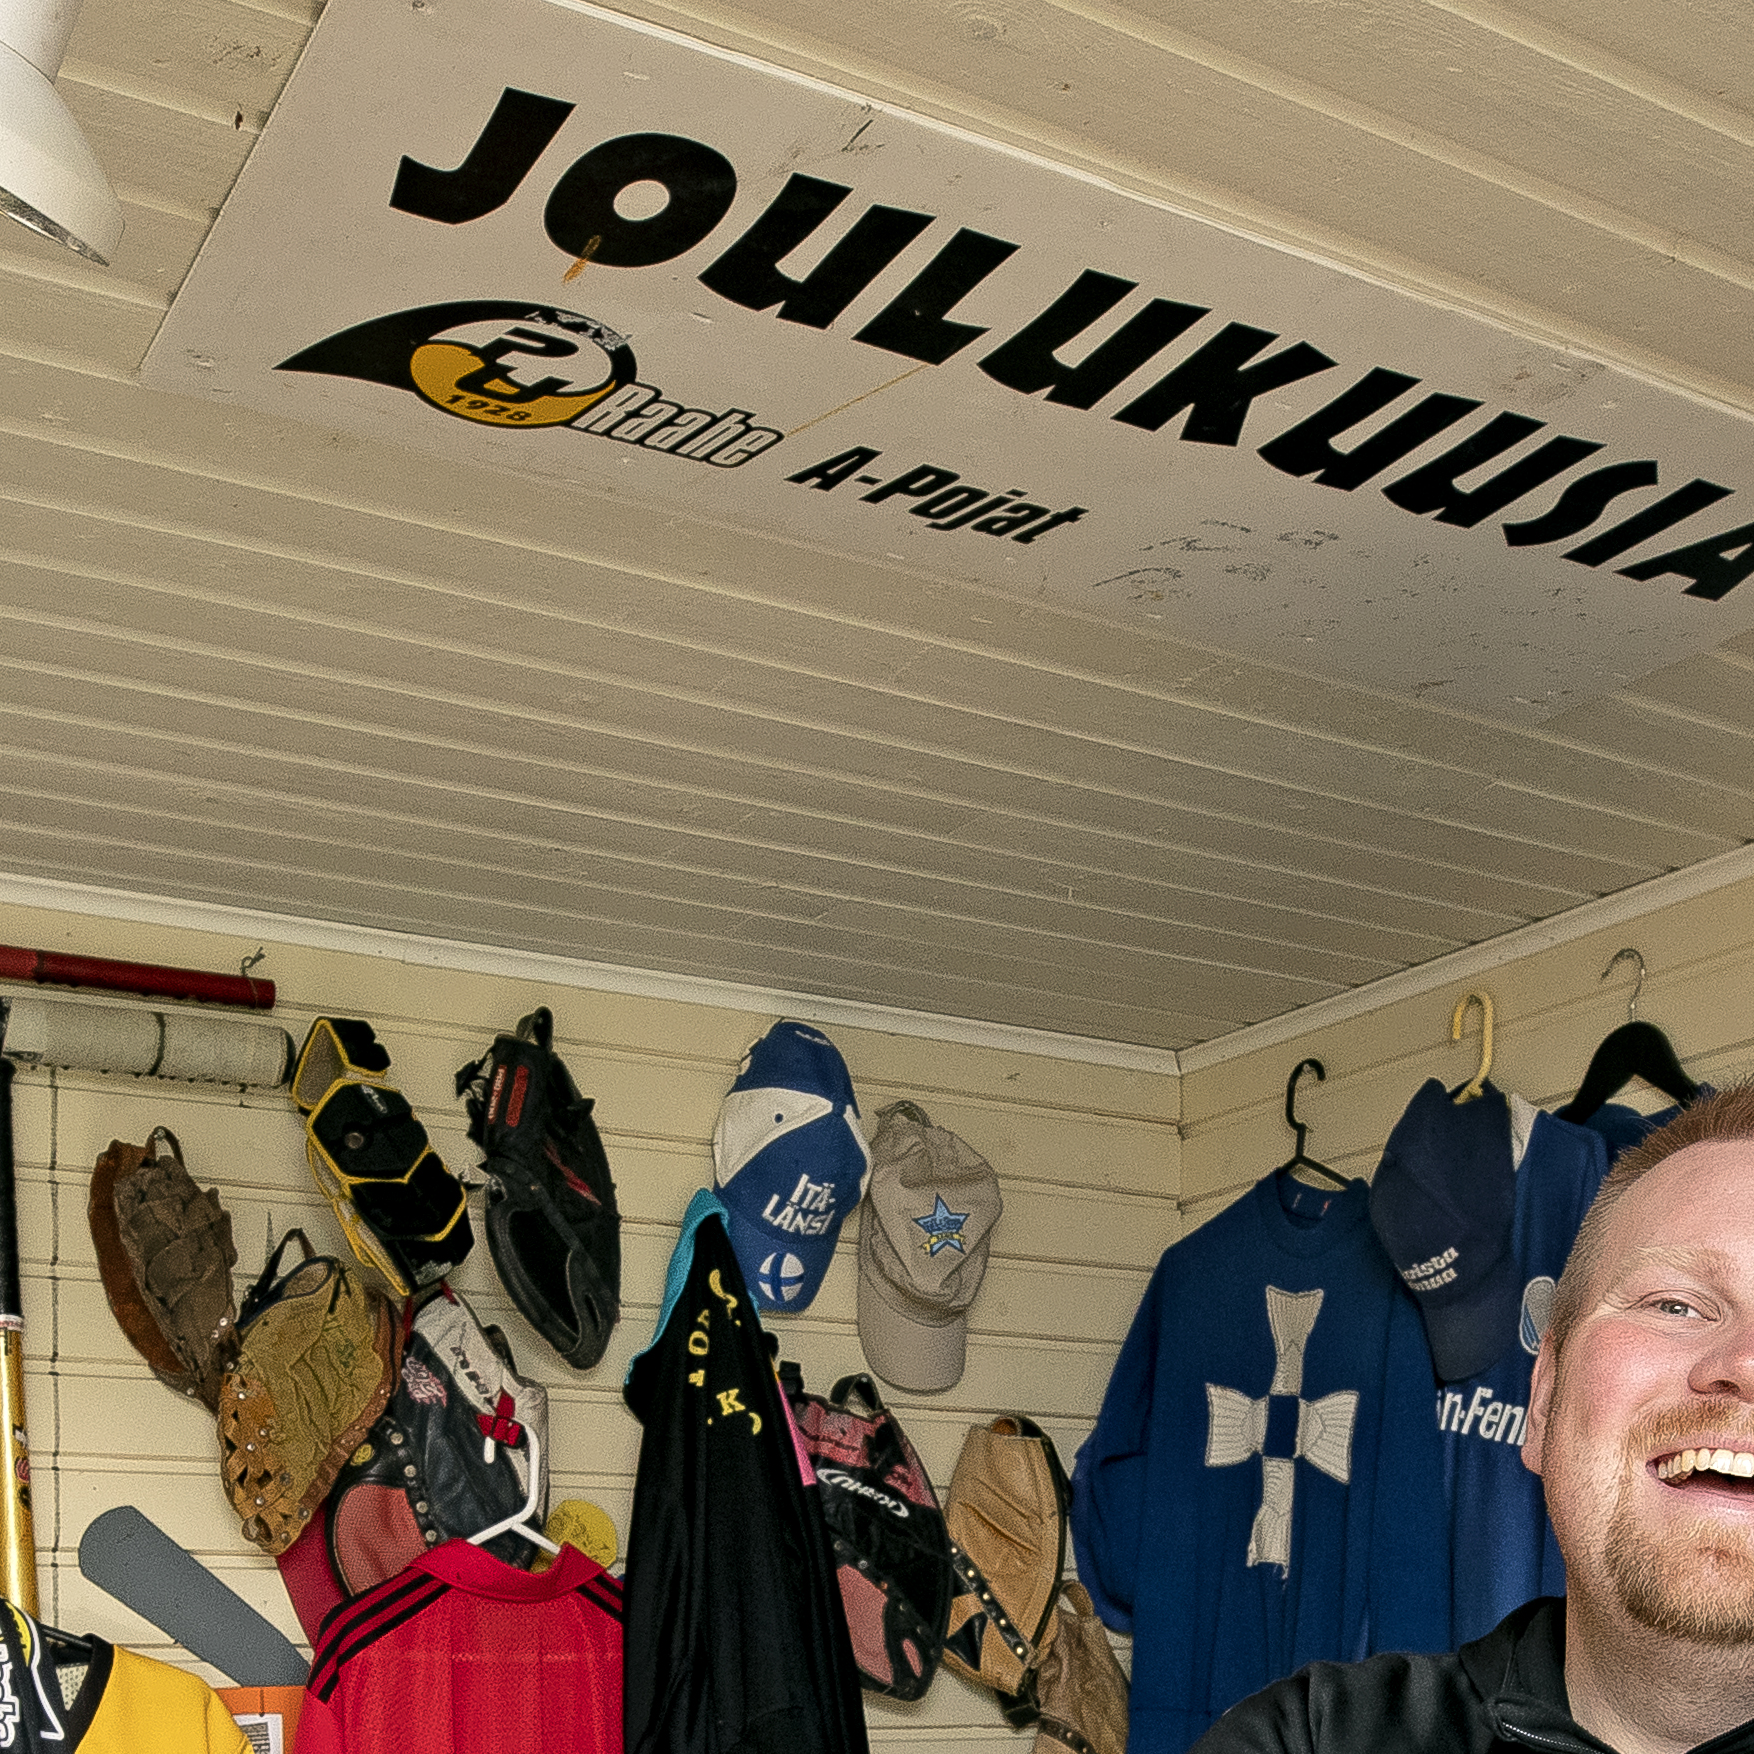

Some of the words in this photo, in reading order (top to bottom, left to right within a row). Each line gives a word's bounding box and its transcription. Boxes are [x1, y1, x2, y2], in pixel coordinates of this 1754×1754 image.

[445, 393, 531, 422] 1928
[573, 383, 785, 468] Raahe
[784, 445, 1089, 545] A-Pojat
[763, 1194, 833, 1235] LÄNSI
